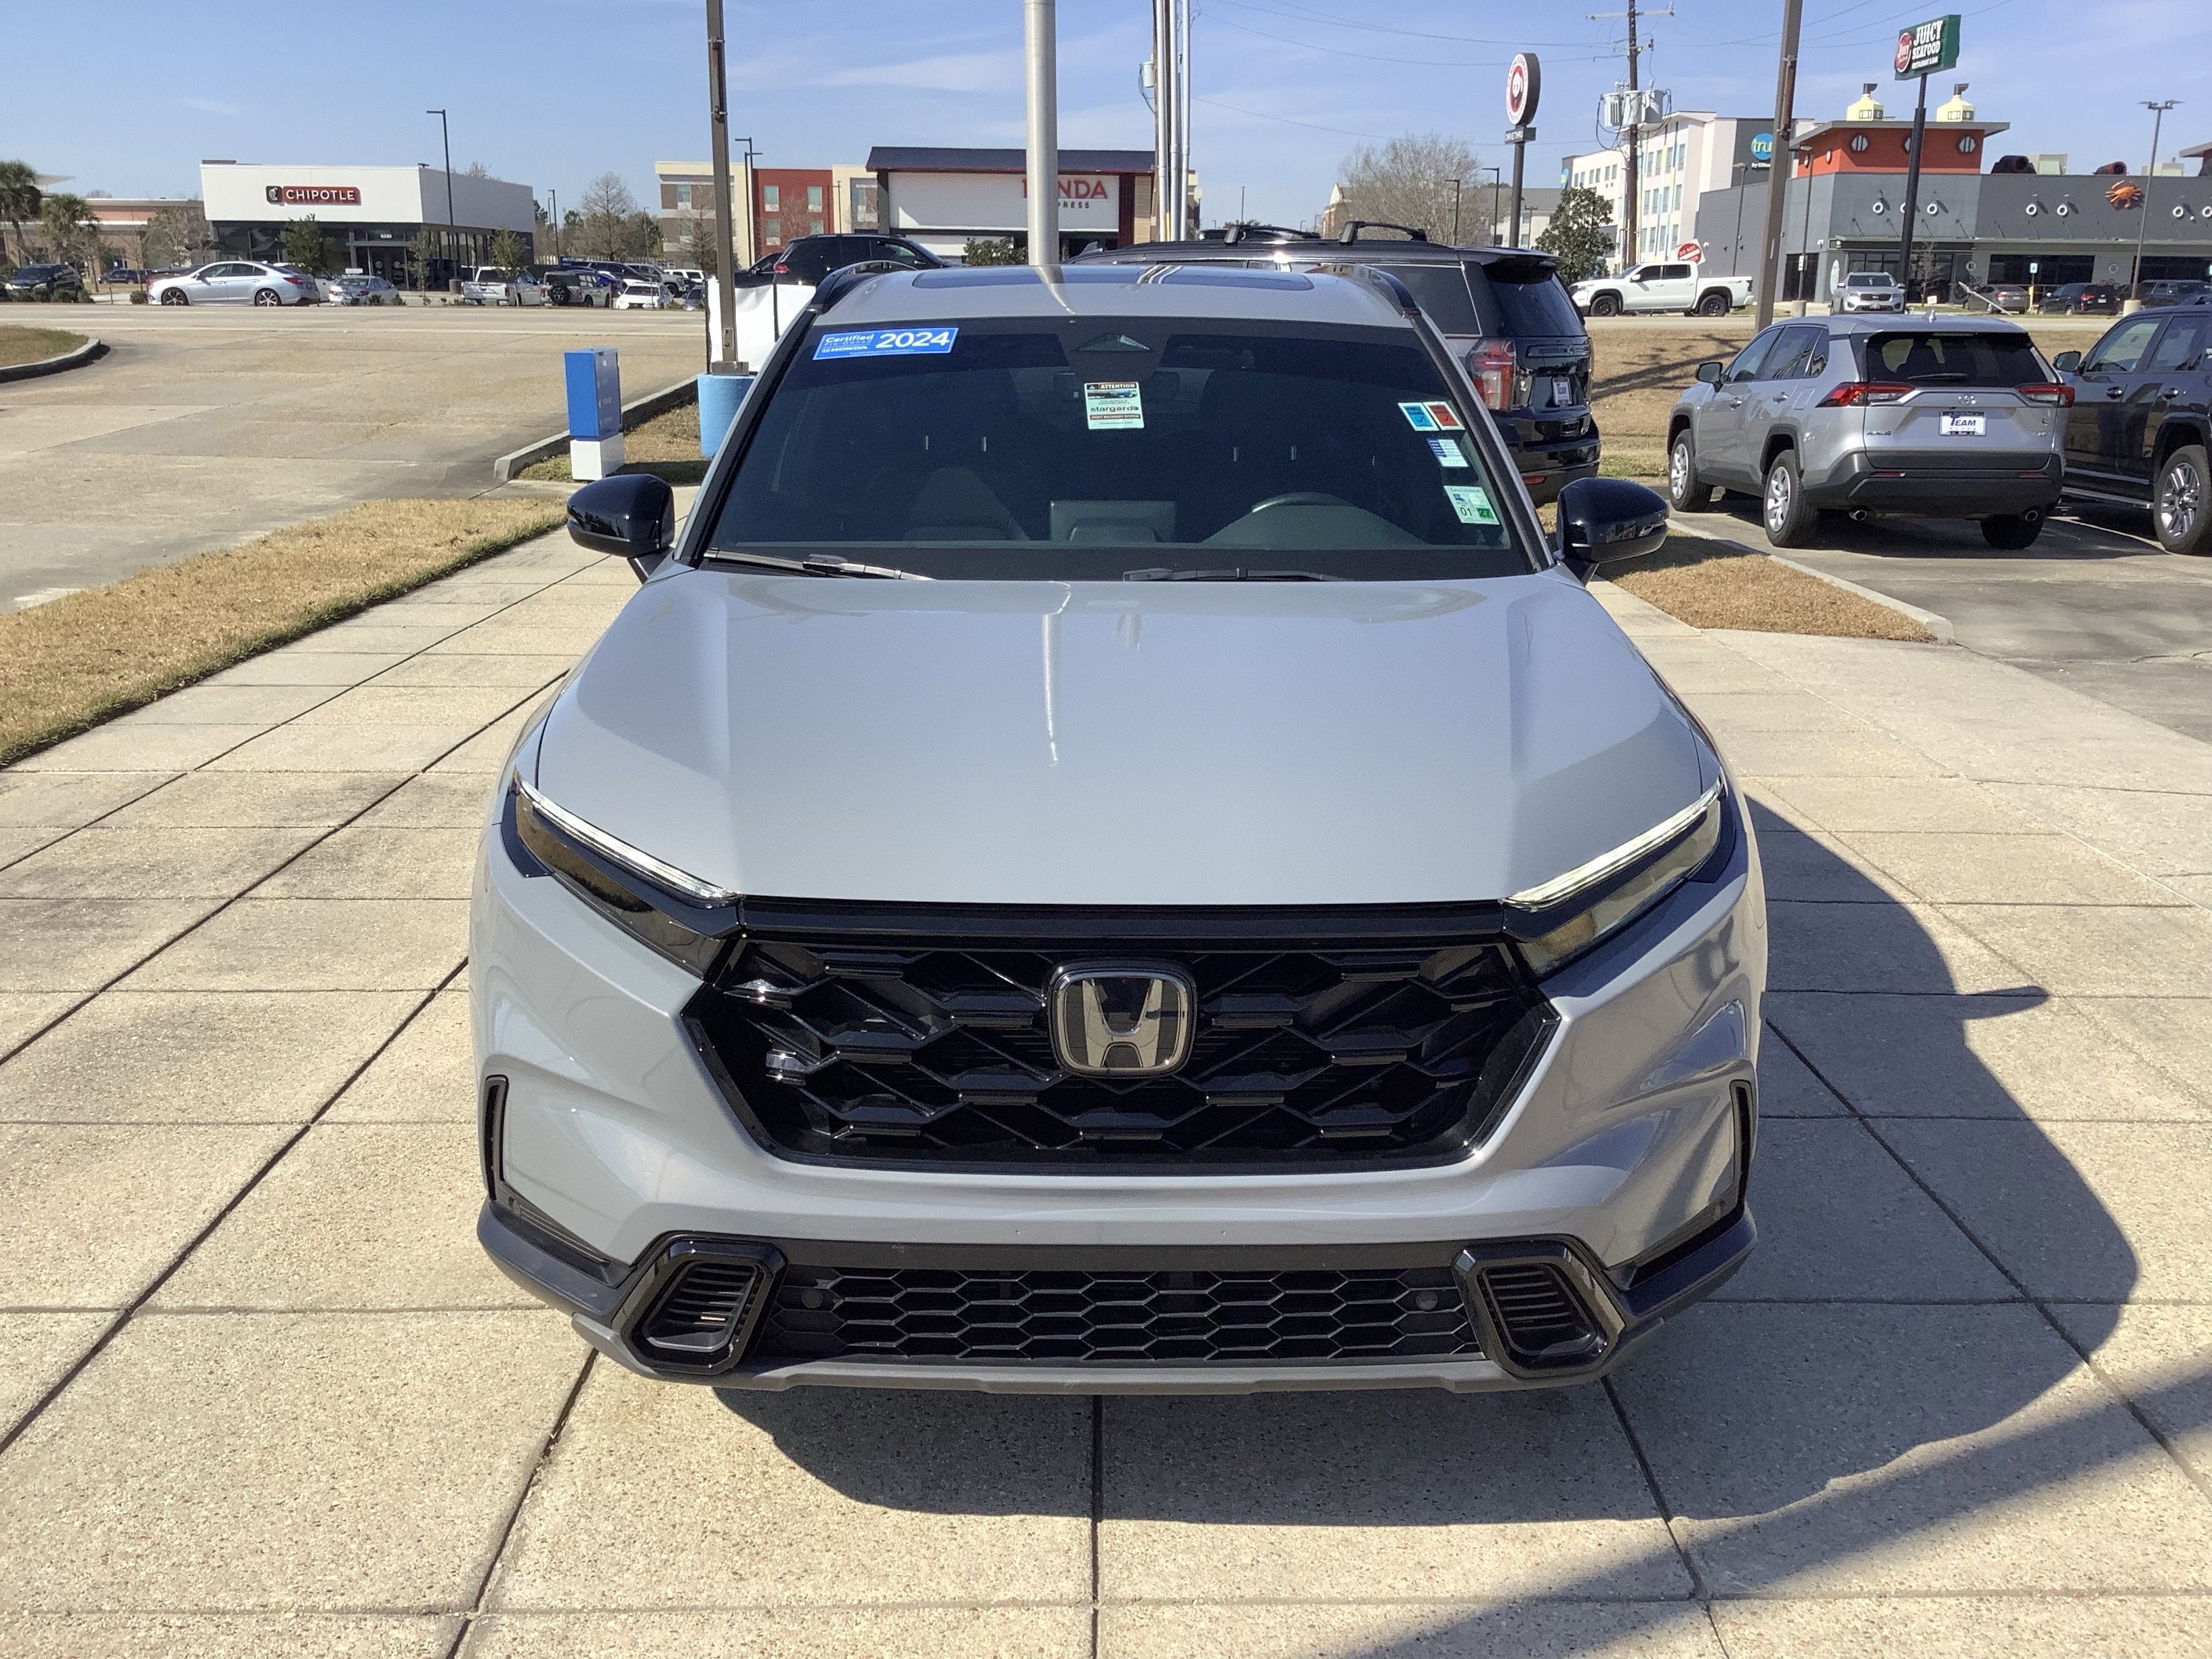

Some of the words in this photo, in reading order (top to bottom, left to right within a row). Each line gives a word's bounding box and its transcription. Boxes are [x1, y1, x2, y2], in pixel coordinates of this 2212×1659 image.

[1913, 20, 1944, 46] JUICY
[1912, 41, 1941, 60] SEAFOOD
[1752, 138, 1772, 152] tru
[286, 189, 355, 201] CHIPOTLE
[1022, 179, 1107, 199] NDA
[825, 334, 874, 343] Certified
[876, 331, 949, 348] 2024
[1950, 412, 1976, 426] TEAM
[1460, 507, 1473, 516] 01
[1477, 508, 1490, 517] 27
